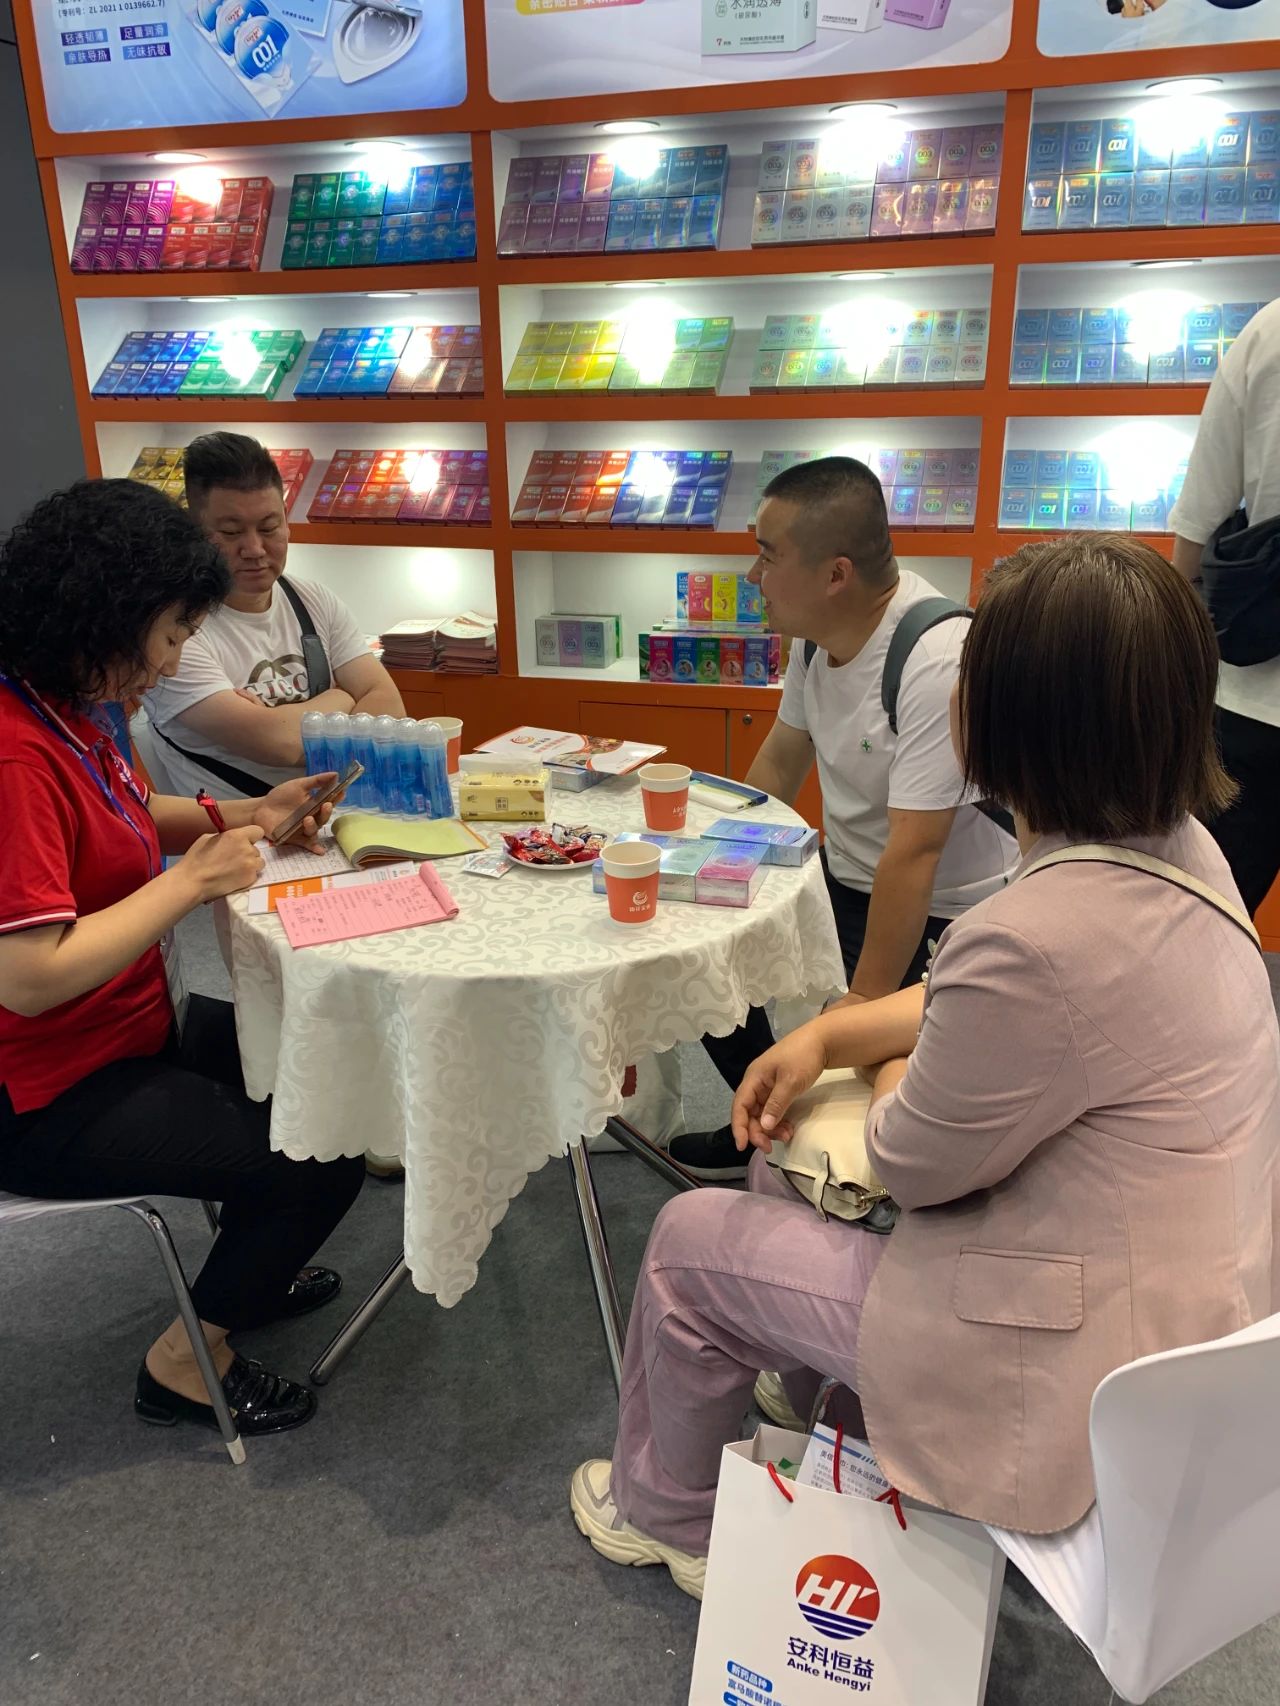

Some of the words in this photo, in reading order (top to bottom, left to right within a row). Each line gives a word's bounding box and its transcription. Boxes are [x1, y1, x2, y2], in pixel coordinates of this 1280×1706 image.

[89, 6, 98, 14] ZL
[99, 4, 117, 13] 2021
[787, 1636, 875, 1680] 安科恒益
[787, 1658, 820, 1676] Anke
[824, 1670, 871, 1692] Hengyi
